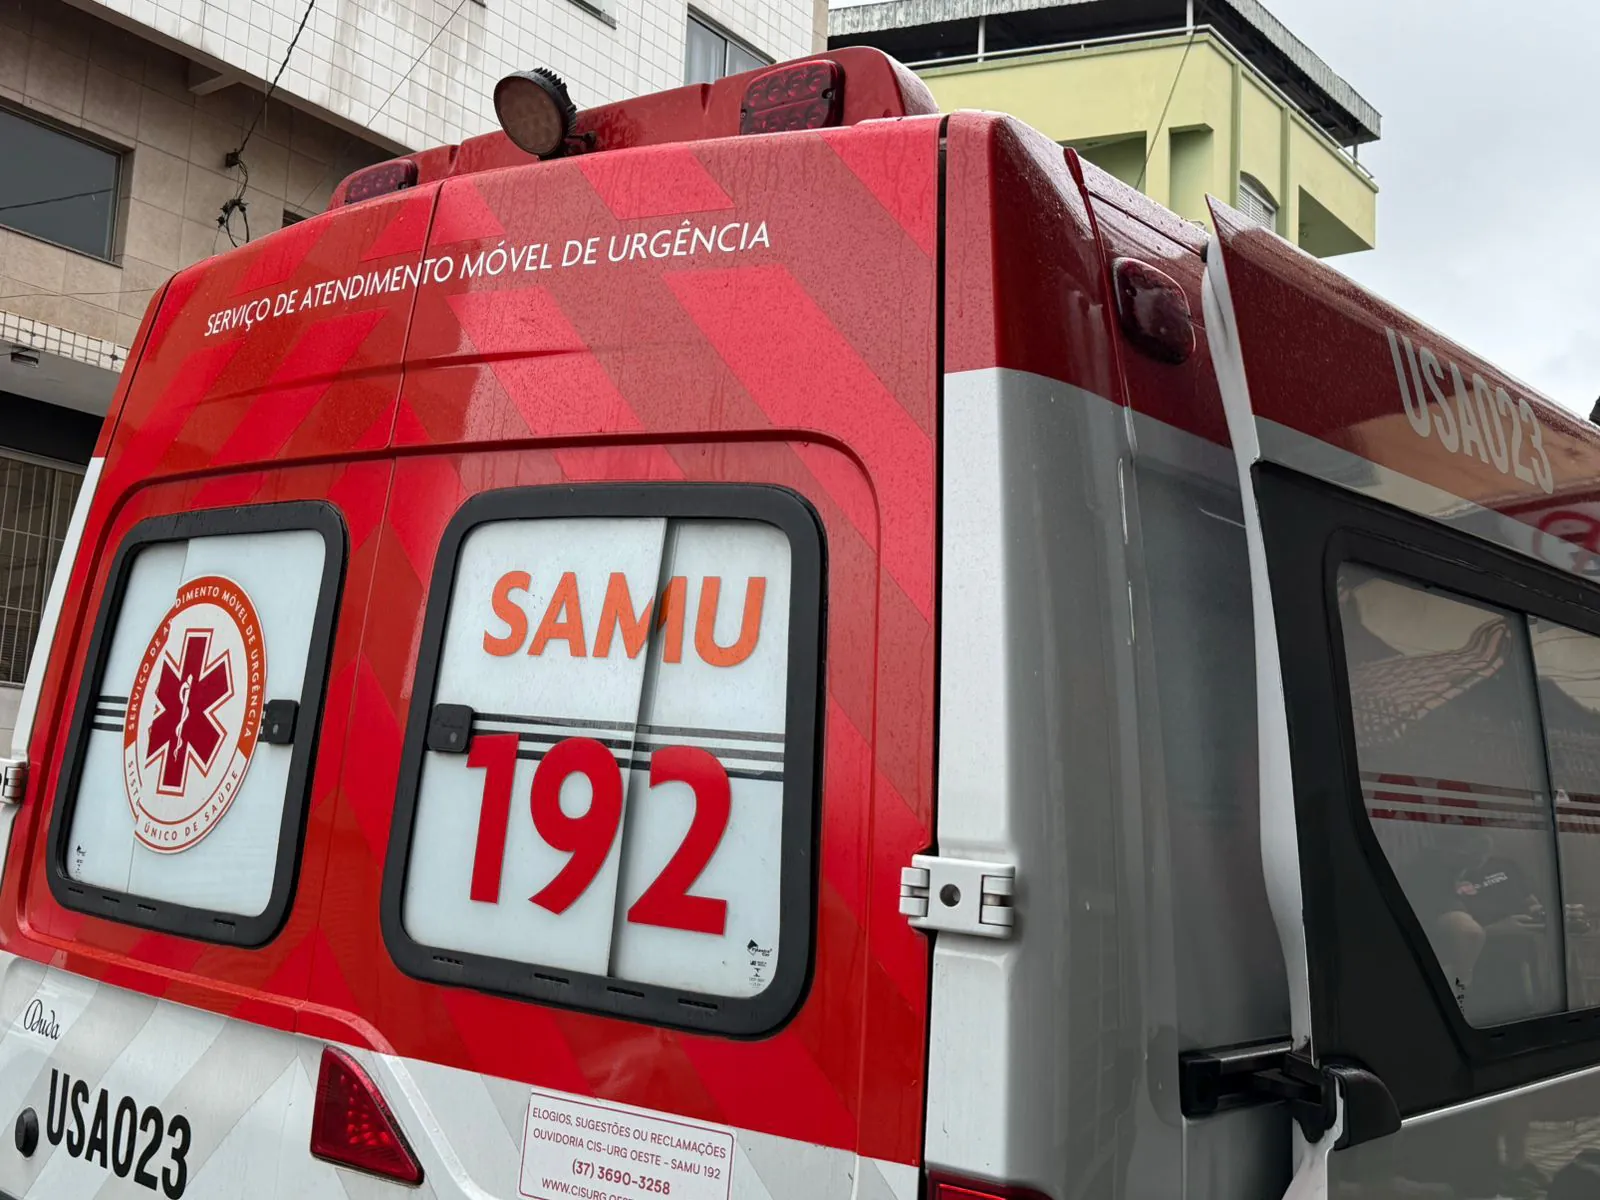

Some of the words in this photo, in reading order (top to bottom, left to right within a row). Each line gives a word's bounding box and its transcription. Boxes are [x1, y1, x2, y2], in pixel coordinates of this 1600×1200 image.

[204, 298, 270, 336] SERVIÇO
[273, 289, 298, 317] DE
[299, 255, 453, 311] ATENDIMENTO
[459, 240, 552, 279] MÓVEL
[561, 237, 600, 267] DE
[607, 219, 770, 262] URGÊNCIA
[1384, 326, 1554, 495] USA023
[221, 590, 248, 625] MÓVEL
[245, 624, 256, 645] DE
[483, 570, 767, 668] SAMU
[150, 638, 161, 657] DE
[128, 663, 149, 730] SERVIÇO
[243, 649, 260, 738] URGÊNCIA
[144, 821, 178, 841] ÚNICO
[184, 821, 198, 836] DE
[204, 770, 238, 821] SAÚDE
[466, 733, 732, 936] 192
[46, 1068, 191, 1200] USA023
[532, 1107, 573, 1127] ELOGIOS,
[575, 1116, 630, 1138] SUGESTÕES
[633, 1128, 648, 1142] OU
[650, 1132, 726, 1159] RECLAMAÇÕES
[533, 1127, 584, 1149] OUVIDORIA
[586, 1138, 628, 1159] CIS-URG
[630, 1147, 661, 1166] OESTE
[671, 1158, 700, 1175] SAMU
[703, 1165, 721, 1180] 192
[572, 1158, 595, 1180] (37)
[597, 1165, 670, 1195] 3690-3258
